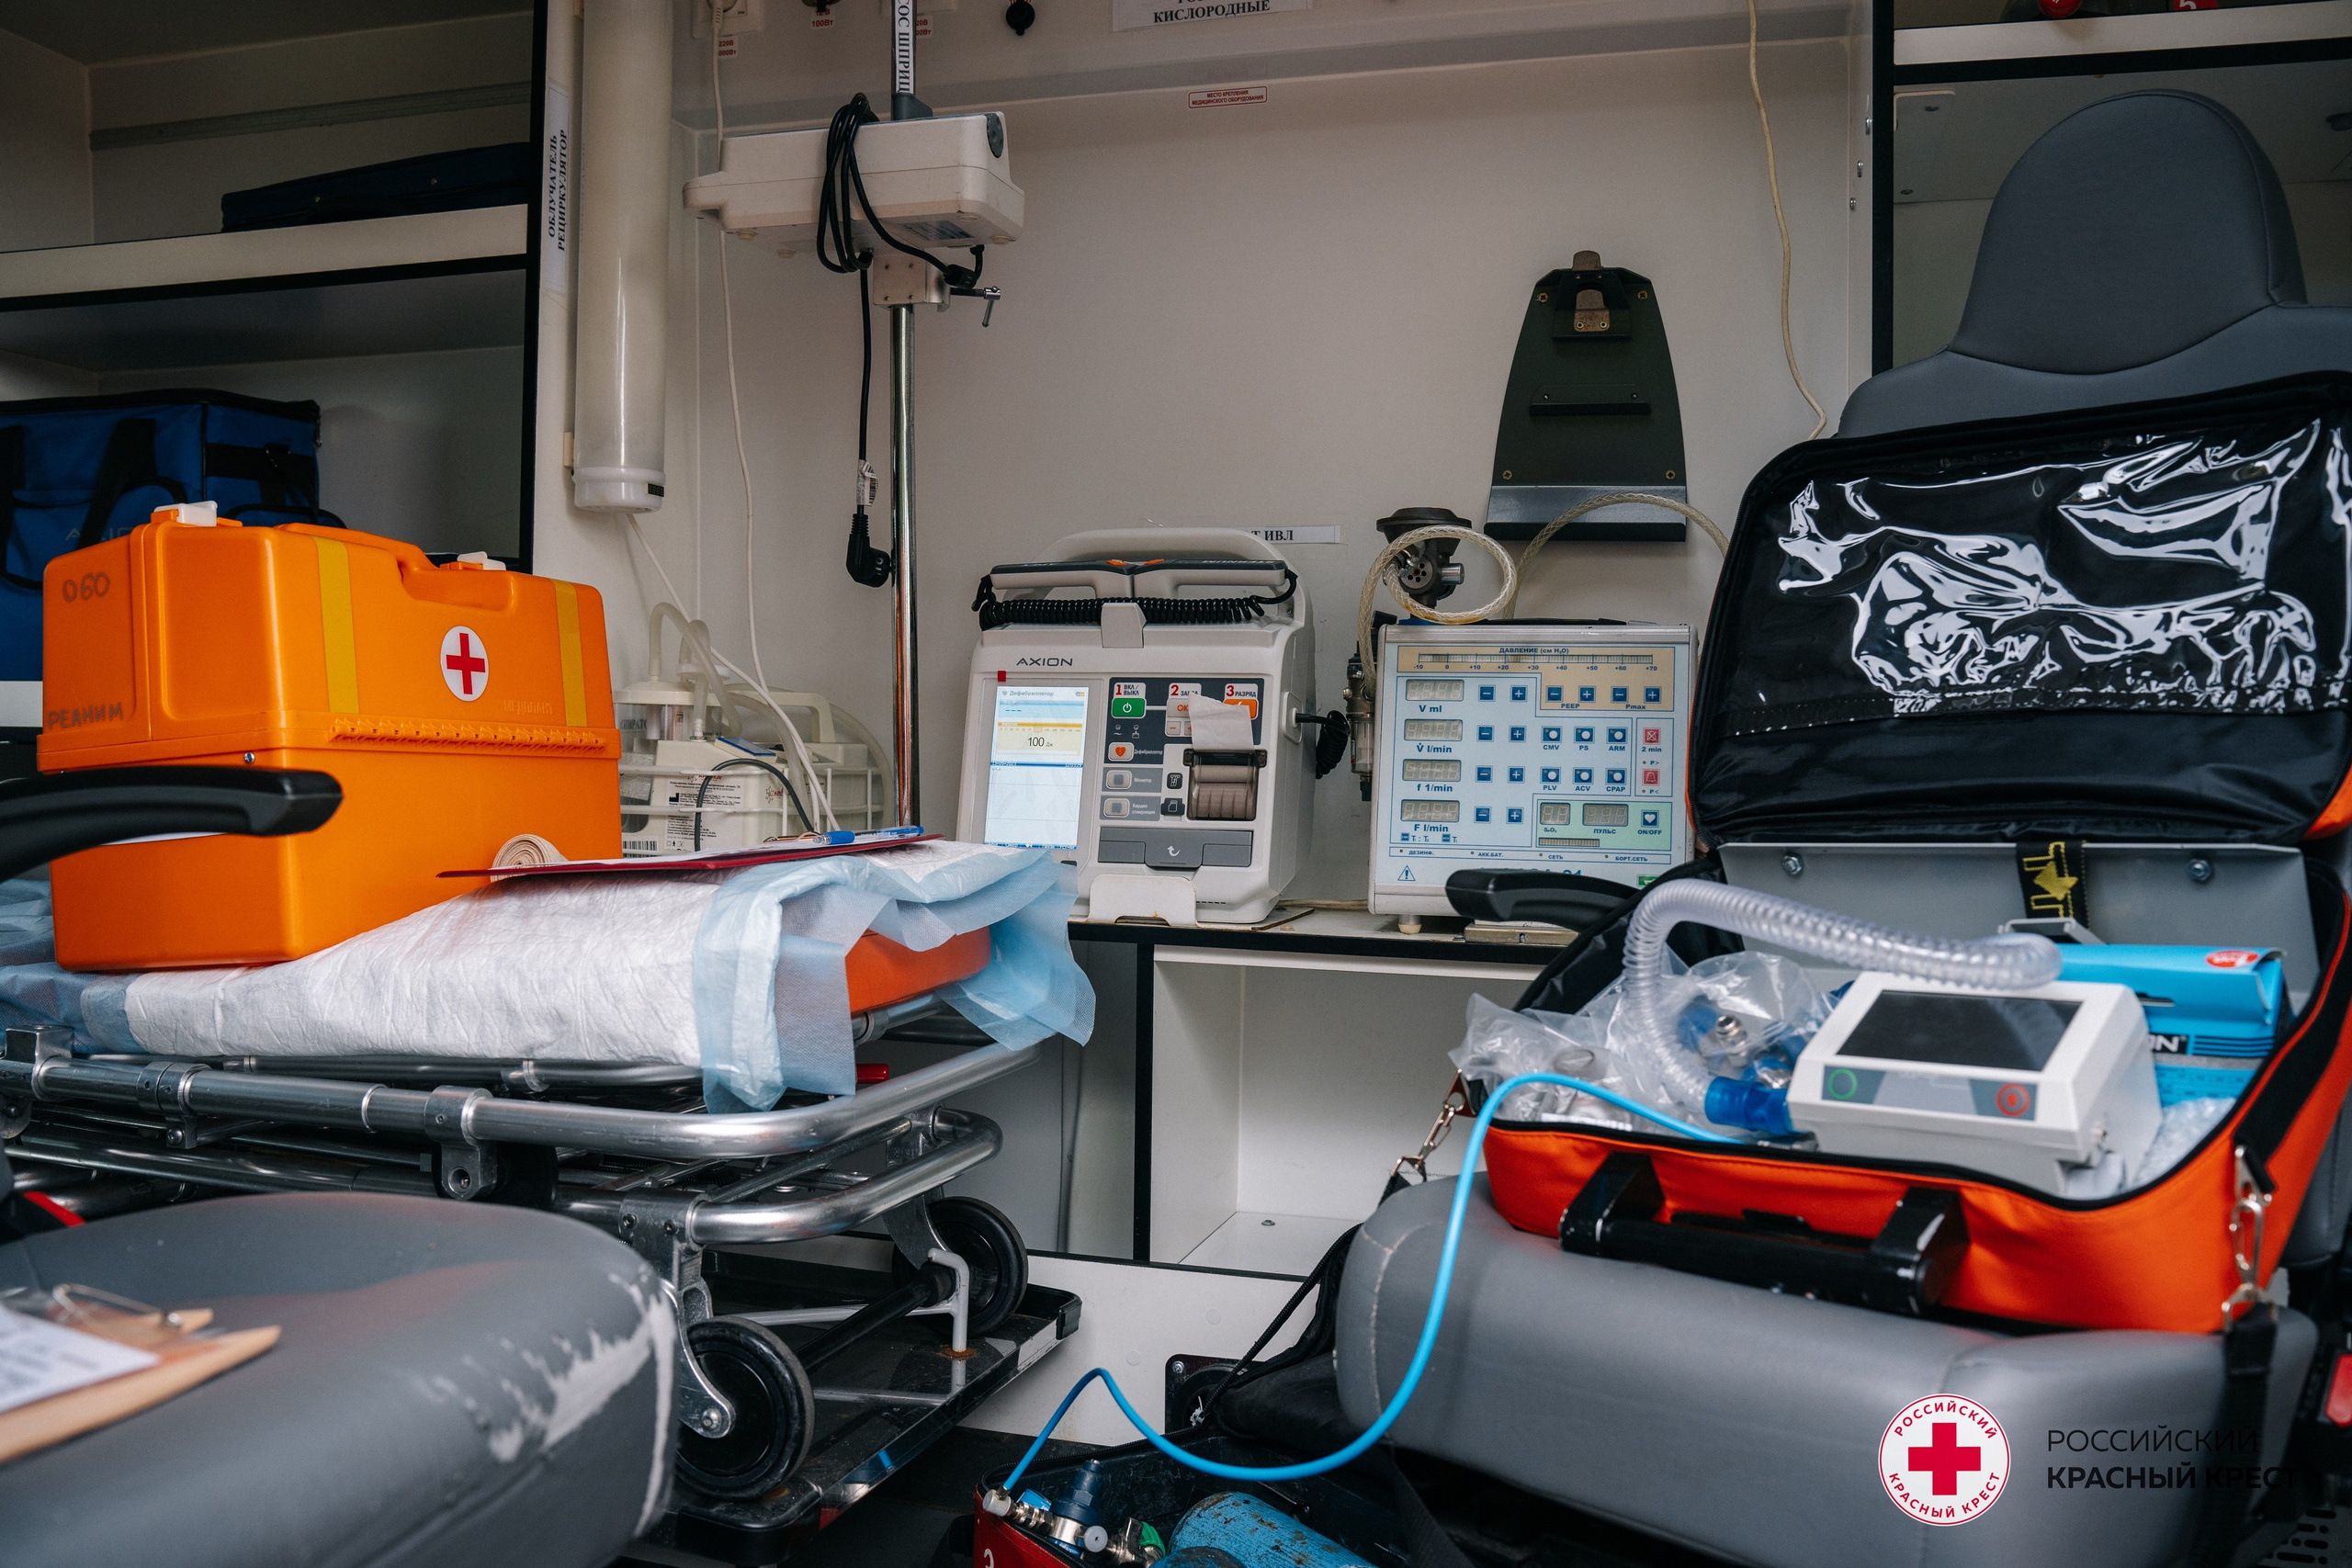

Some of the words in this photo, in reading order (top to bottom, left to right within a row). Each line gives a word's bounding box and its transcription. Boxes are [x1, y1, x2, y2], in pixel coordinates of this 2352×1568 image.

[1152, 0, 1272, 24] КИСЛОРОДНЫЕ
[811, 19, 834, 28] 100Вт
[1192, 97, 1227, 106] МЕДИЦИНСКОГО
[1228, 95, 1264, 103] ОБОРУДОВАНИЯ
[548, 135, 558, 238] ОБЛУЧАТЕЛЬ
[558, 130, 568, 251] РЕЦИРКУЛЯТОР
[1264, 530, 1294, 541] ИВЛ
[1016, 657, 1073, 667] AXION
[1115, 684, 1122, 695] 1
[1170, 684, 1179, 695] 2
[1227, 685, 1234, 696] 3
[1419, 705, 1426, 713] V
[1430, 705, 1442, 713] ml
[48, 702, 123, 729] РЕАНИМ
[1028, 737, 1045, 747] 100
[1417, 784, 1421, 792] f
[1414, 824, 1420, 832] F
